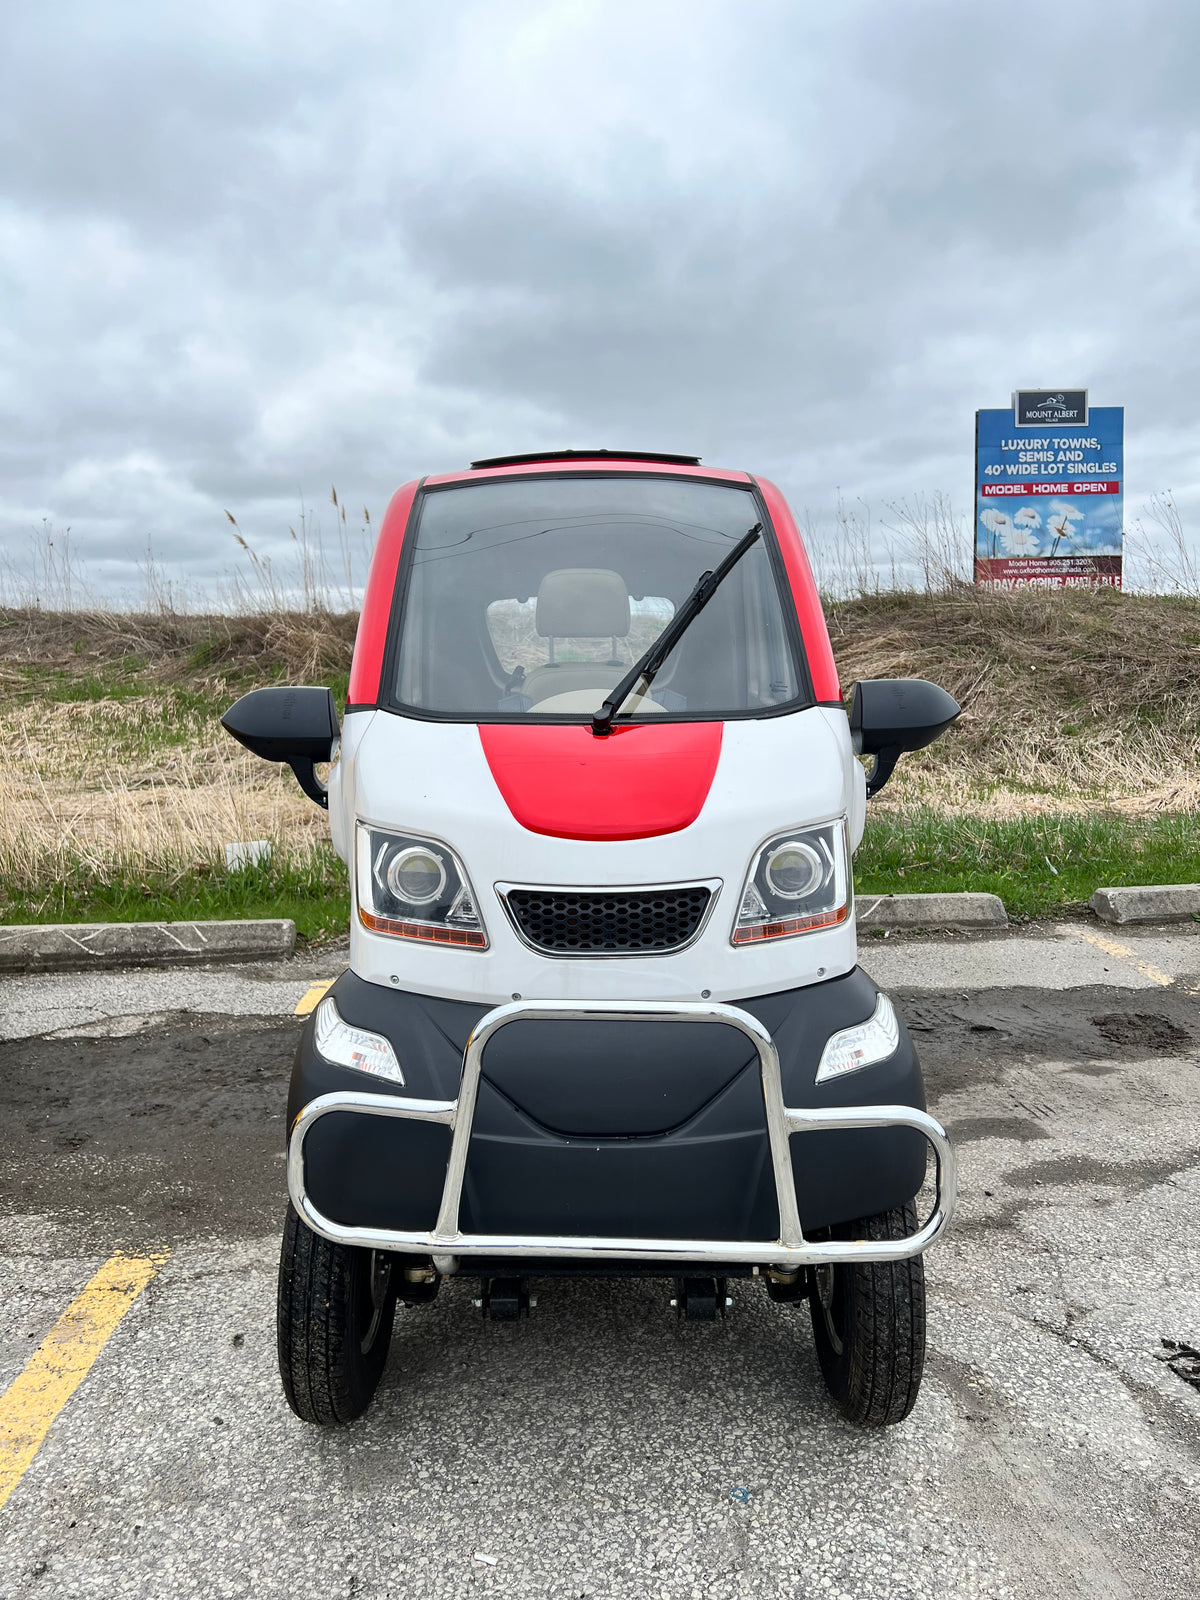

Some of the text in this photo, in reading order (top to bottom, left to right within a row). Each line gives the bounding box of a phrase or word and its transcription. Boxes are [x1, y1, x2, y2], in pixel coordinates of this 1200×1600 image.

[1026, 410, 1078, 419] MOUNT ALBERT
[1002, 438, 1101, 450] LUXURY TOWNS,
[1018, 451, 1084, 463] SEMIS AND
[984, 462, 1117, 476] 40' WIDE LOT SINGLES
[985, 483, 1107, 495] MODEL HOME OPEN
[994, 577, 1015, 591] DAY
